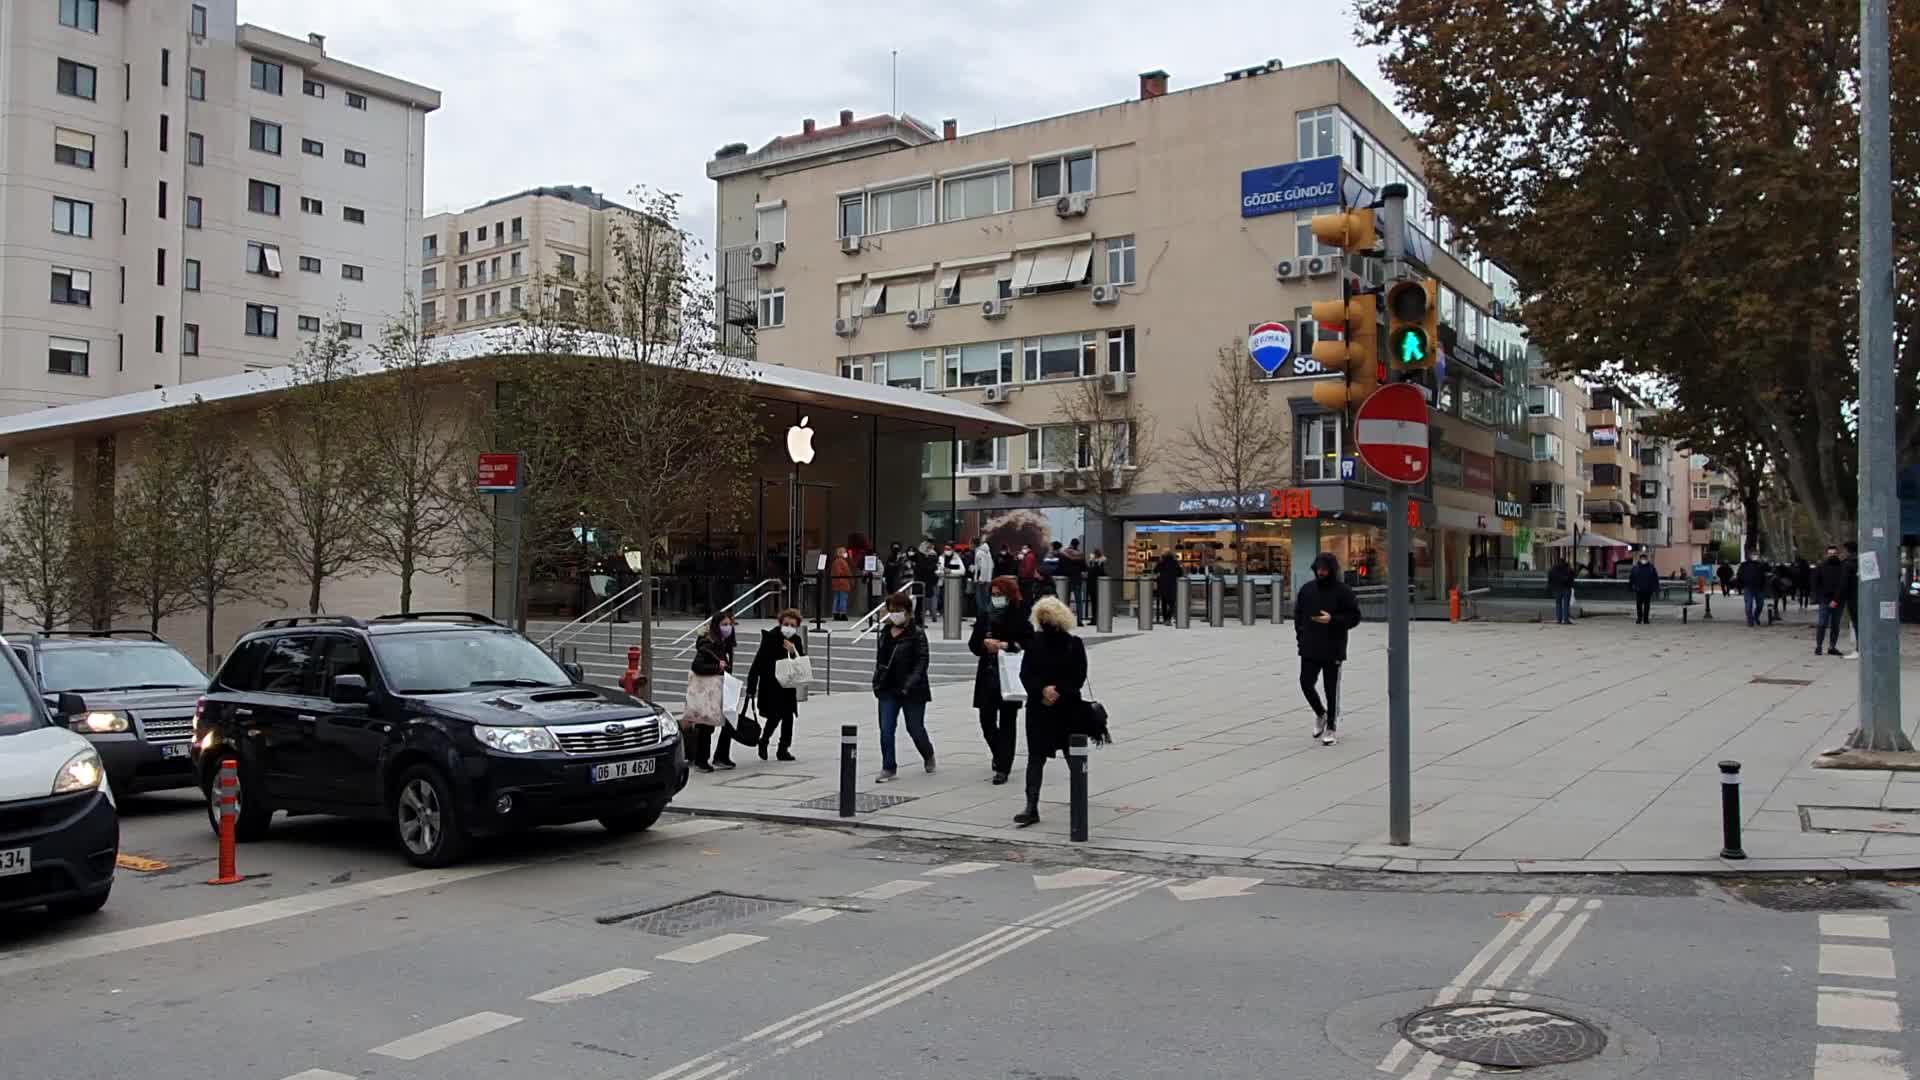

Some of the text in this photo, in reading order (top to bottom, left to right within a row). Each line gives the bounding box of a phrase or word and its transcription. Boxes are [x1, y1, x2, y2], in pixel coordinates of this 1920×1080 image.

[1243, 191, 1283, 207] GÖZDE
[1284, 182, 1335, 201] GÜNDÜZ
[1270, 487, 1319, 518] JBL
[598, 759, 655, 780] 06 YB 4620
[0, 850, 25, 869] 34
